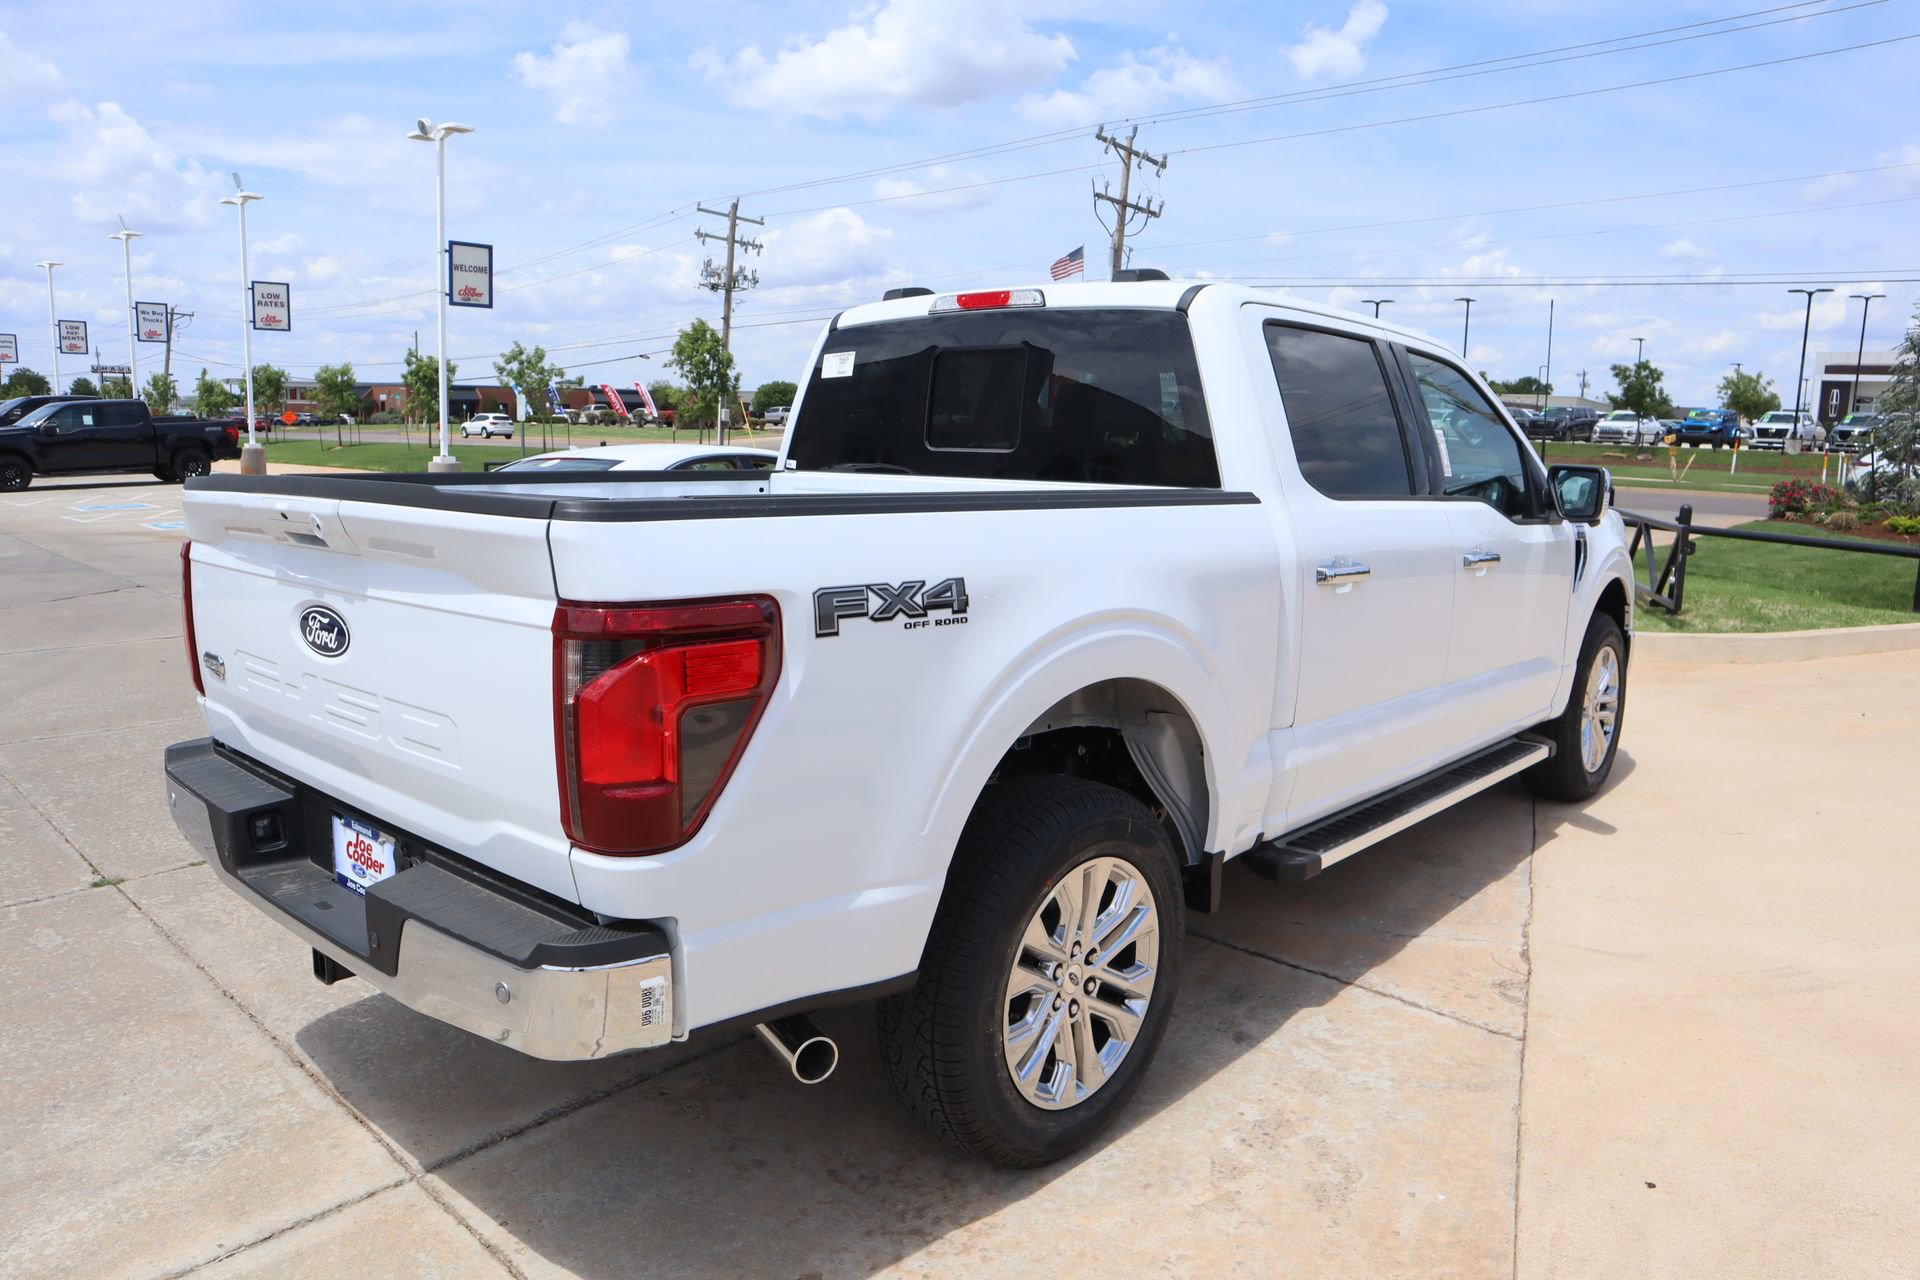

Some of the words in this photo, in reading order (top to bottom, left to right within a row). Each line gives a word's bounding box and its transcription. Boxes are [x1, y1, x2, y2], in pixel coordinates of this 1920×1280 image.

[453, 264, 488, 274] WELCOME
[257, 300, 285, 308] RATES
[261, 292, 281, 300] LOW
[812, 577, 969, 638] FX4
[306, 612, 338, 649] Ford
[904, 618, 930, 630] OFF
[935, 616, 969, 627] ROAD
[351, 820, 373, 838] Edmond
[353, 832, 373, 857] Joe
[346, 840, 385, 875] Cooper
[346, 878, 356, 891] Joe
[356, 884, 366, 896] Coo
